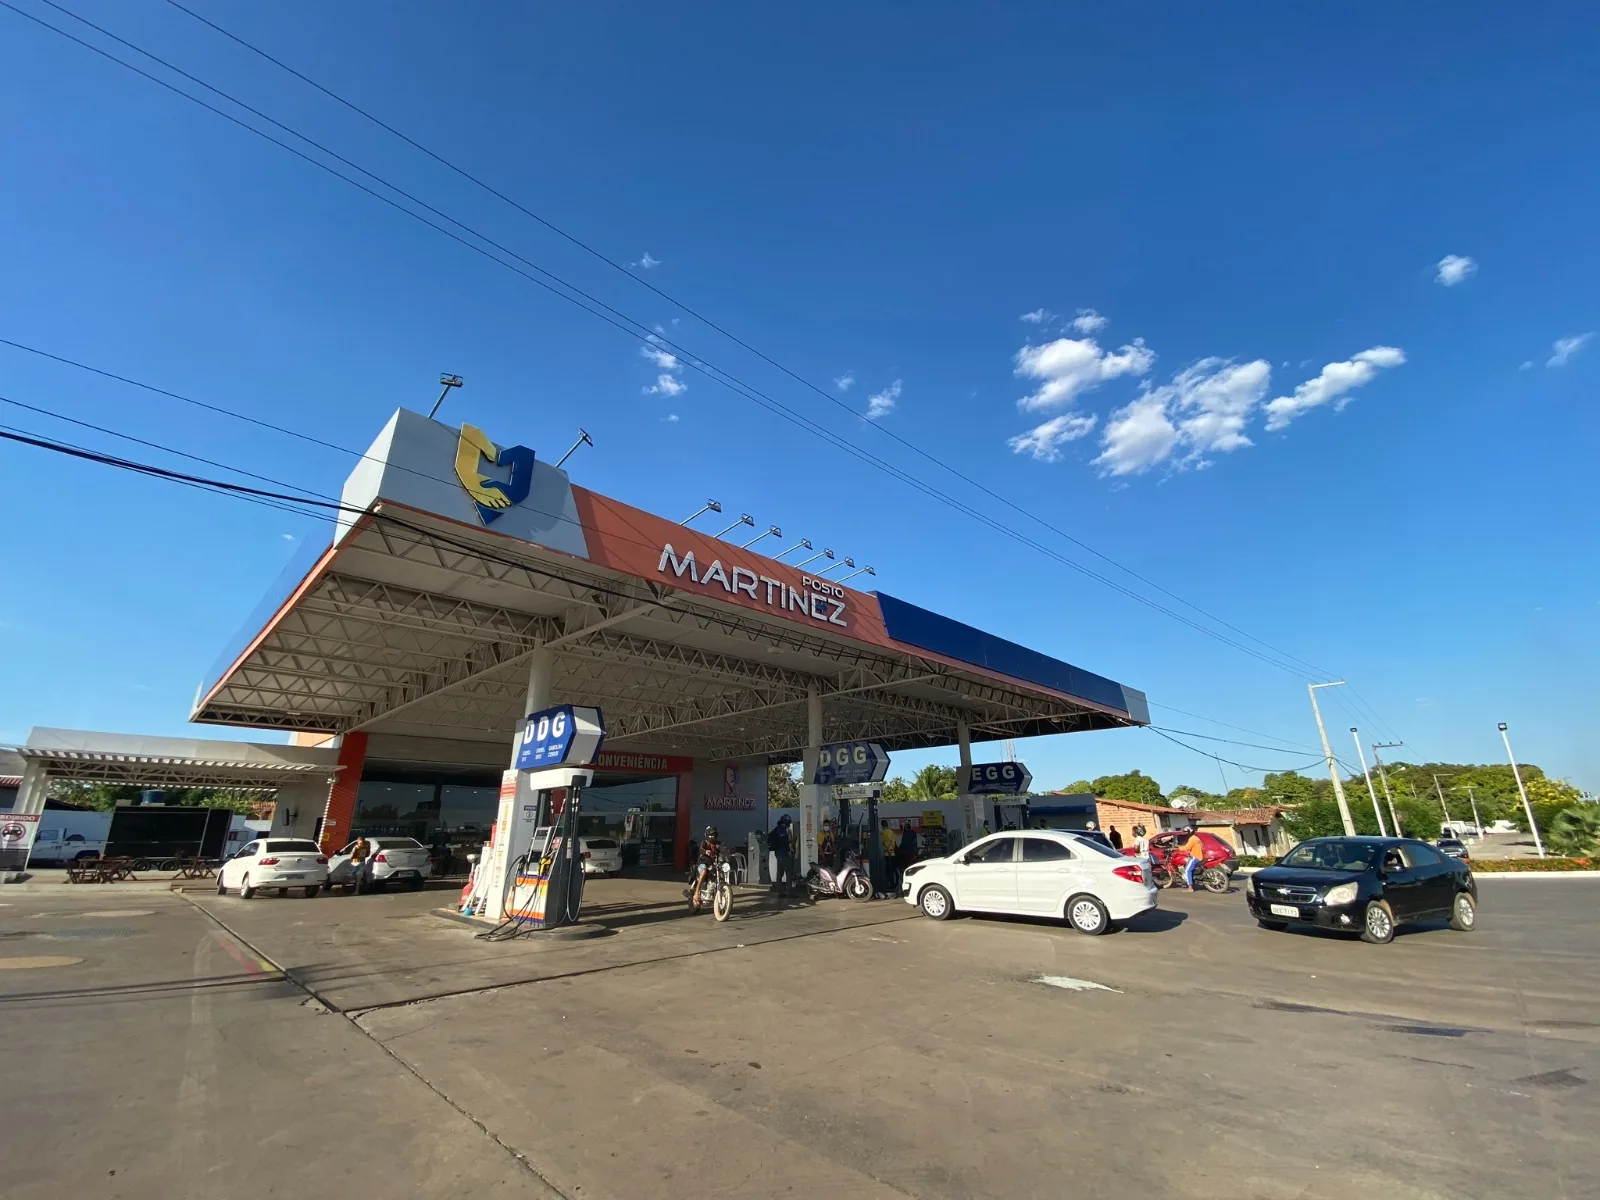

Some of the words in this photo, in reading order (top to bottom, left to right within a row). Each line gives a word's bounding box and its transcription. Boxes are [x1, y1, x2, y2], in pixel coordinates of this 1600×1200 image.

[658, 543, 848, 627] MARTINEZ
[802, 575, 845, 598] POSTO
[592, 754, 668, 770] ONVENIÊNCIA
